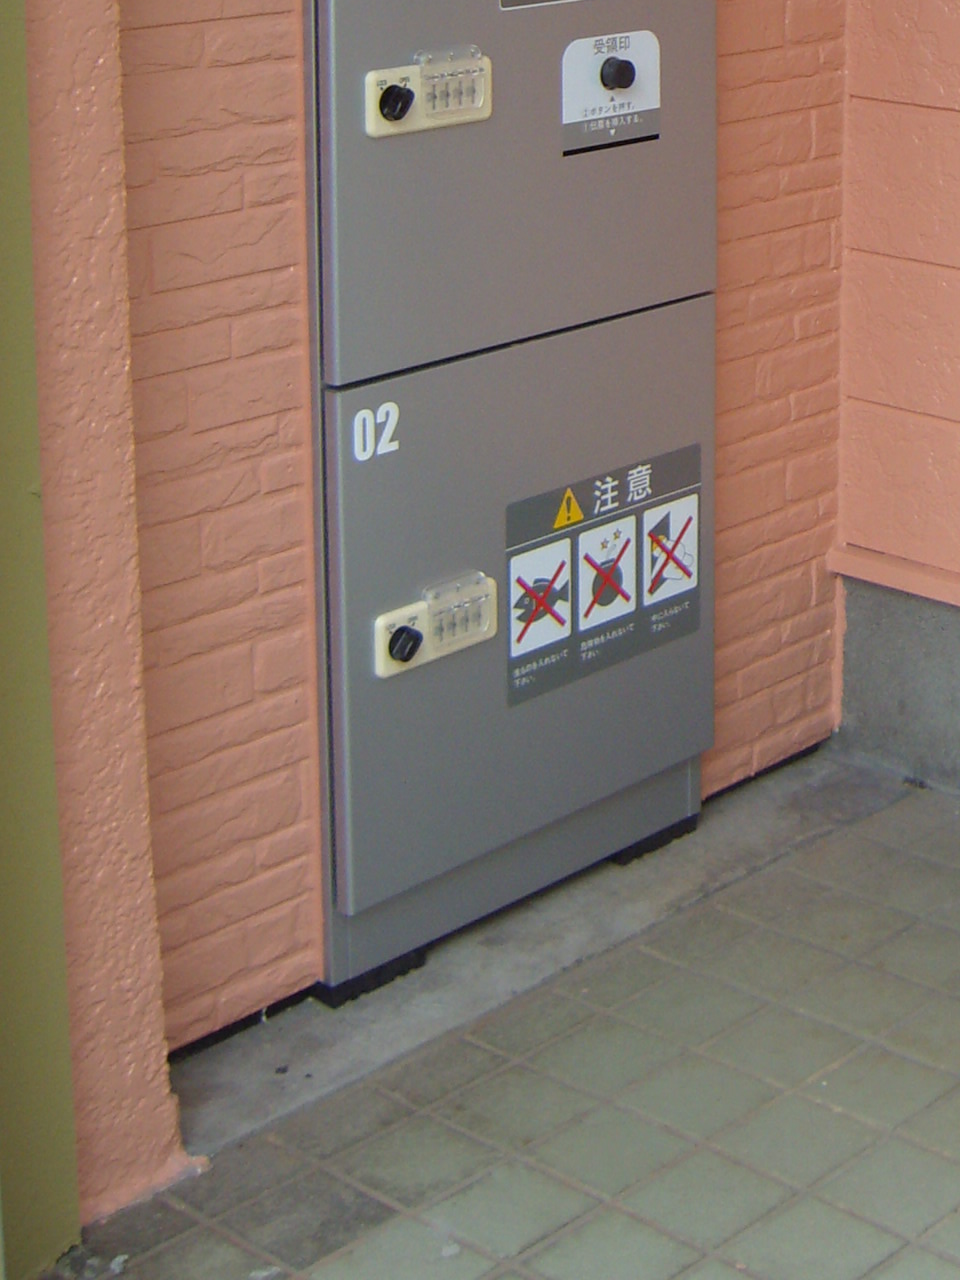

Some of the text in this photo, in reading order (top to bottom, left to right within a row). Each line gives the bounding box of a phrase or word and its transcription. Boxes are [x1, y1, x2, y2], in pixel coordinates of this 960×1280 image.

[594, 35, 630, 55] 受領印
[354, 401, 400, 461] 02
[594, 463, 653, 514] 注意
